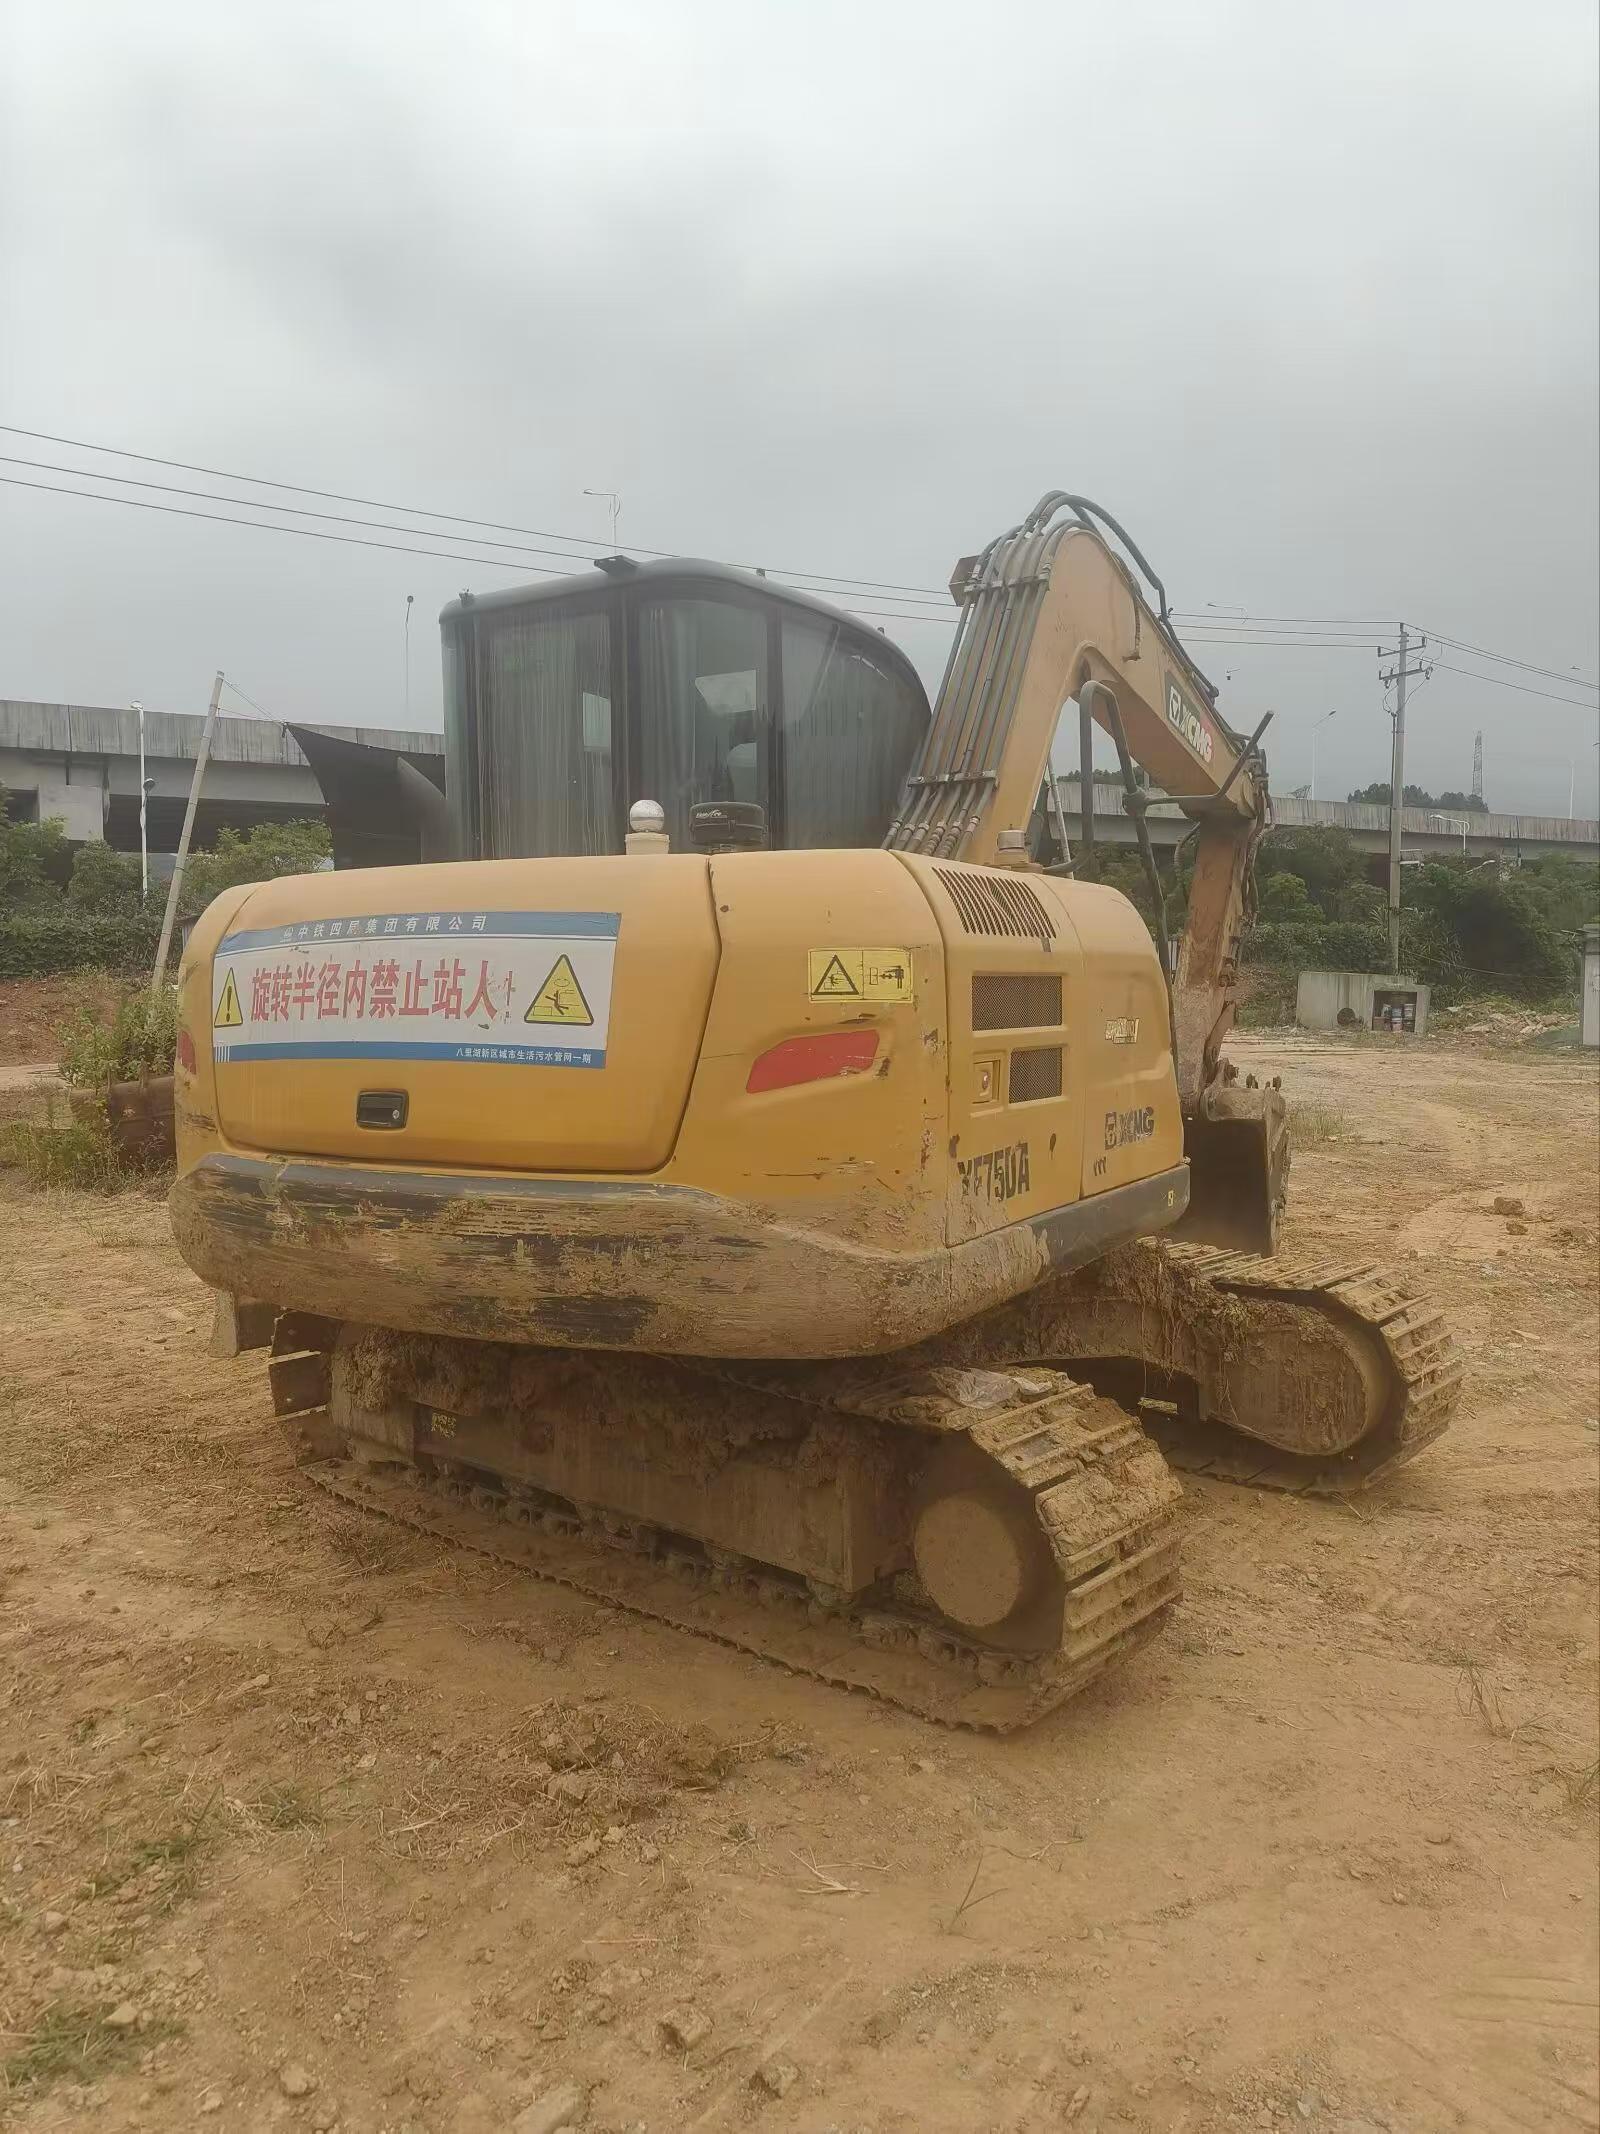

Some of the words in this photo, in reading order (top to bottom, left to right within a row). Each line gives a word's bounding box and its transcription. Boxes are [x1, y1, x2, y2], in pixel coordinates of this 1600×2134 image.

[1180, 704, 1212, 763] XCMG
[298, 915, 487, 940] 中铁四局集团有限公司
